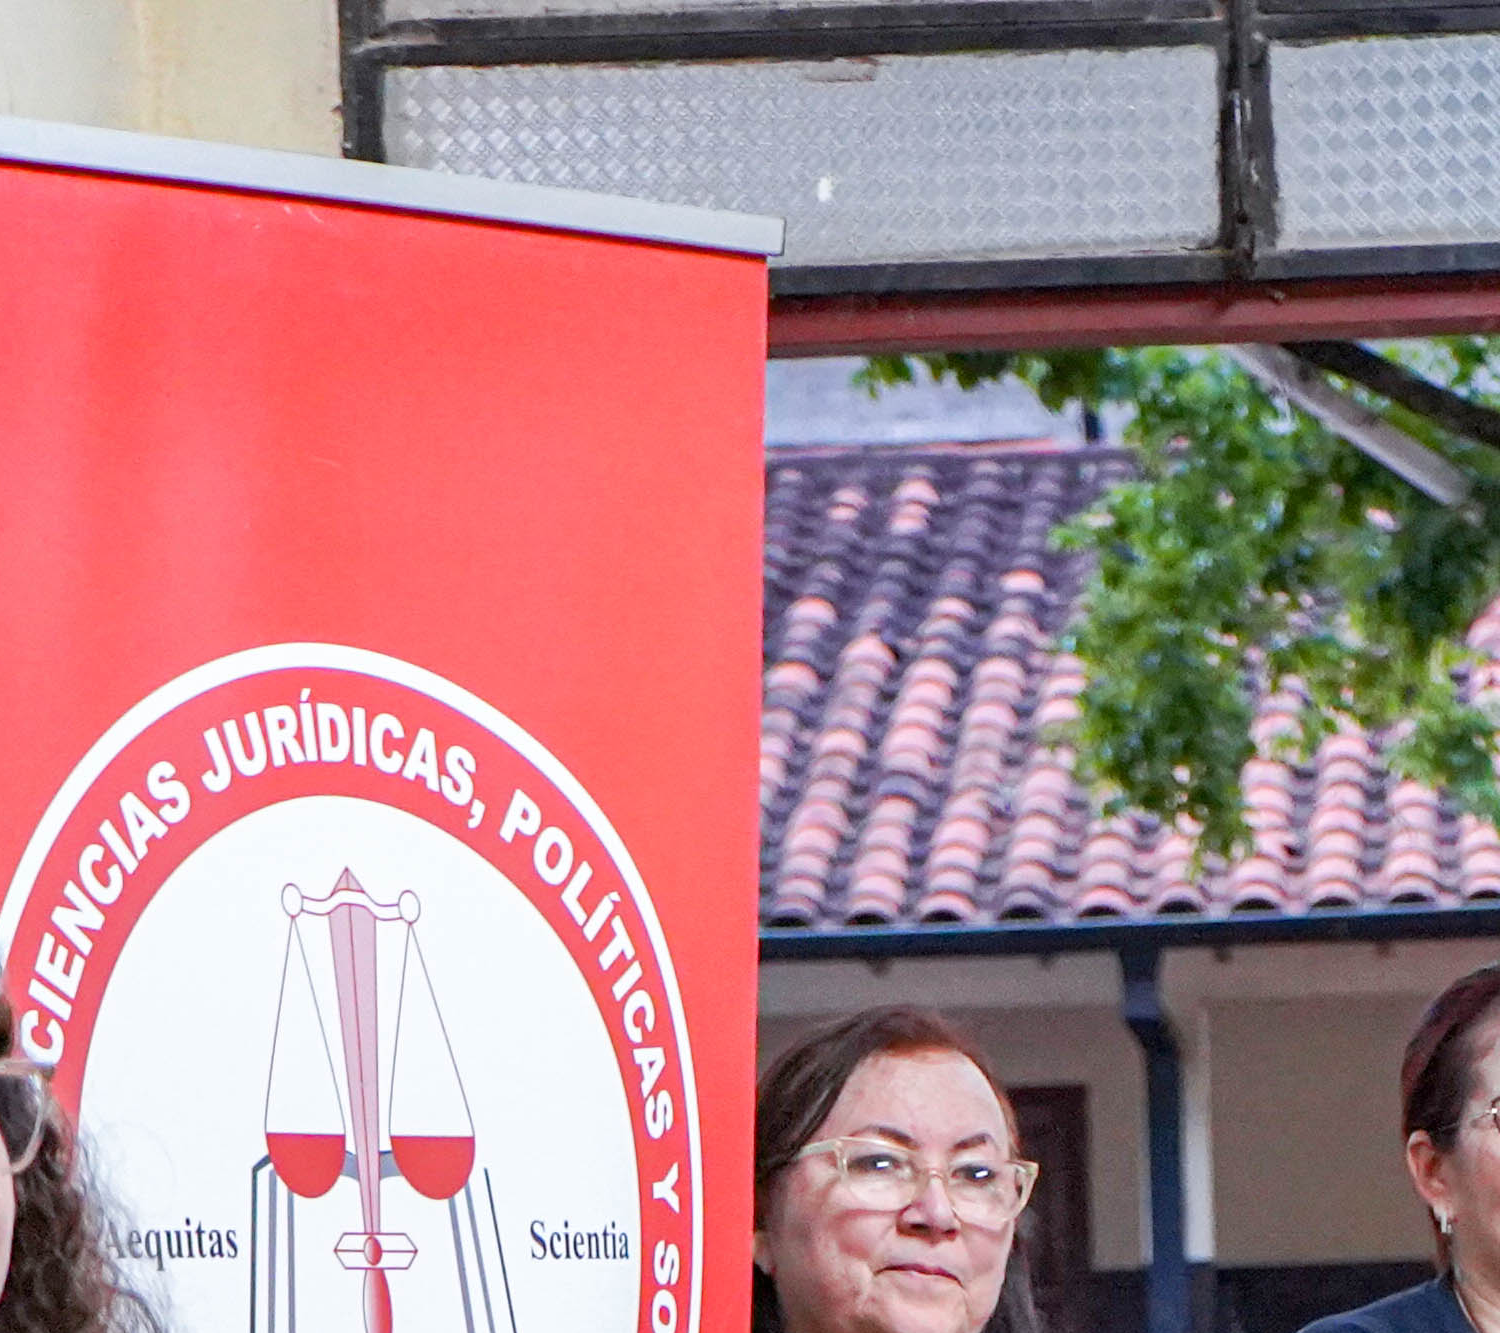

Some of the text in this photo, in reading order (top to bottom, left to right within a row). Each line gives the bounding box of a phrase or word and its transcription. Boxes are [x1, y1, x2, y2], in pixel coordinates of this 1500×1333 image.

[20, 760, 192, 1066] CIENCIAS
[201, 687, 486, 829] JURÍDICAS,
[499, 788, 675, 1140] POLÍTICAS
[652, 1162, 681, 1214] Y
[529, 1219, 630, 1261] Scientia
